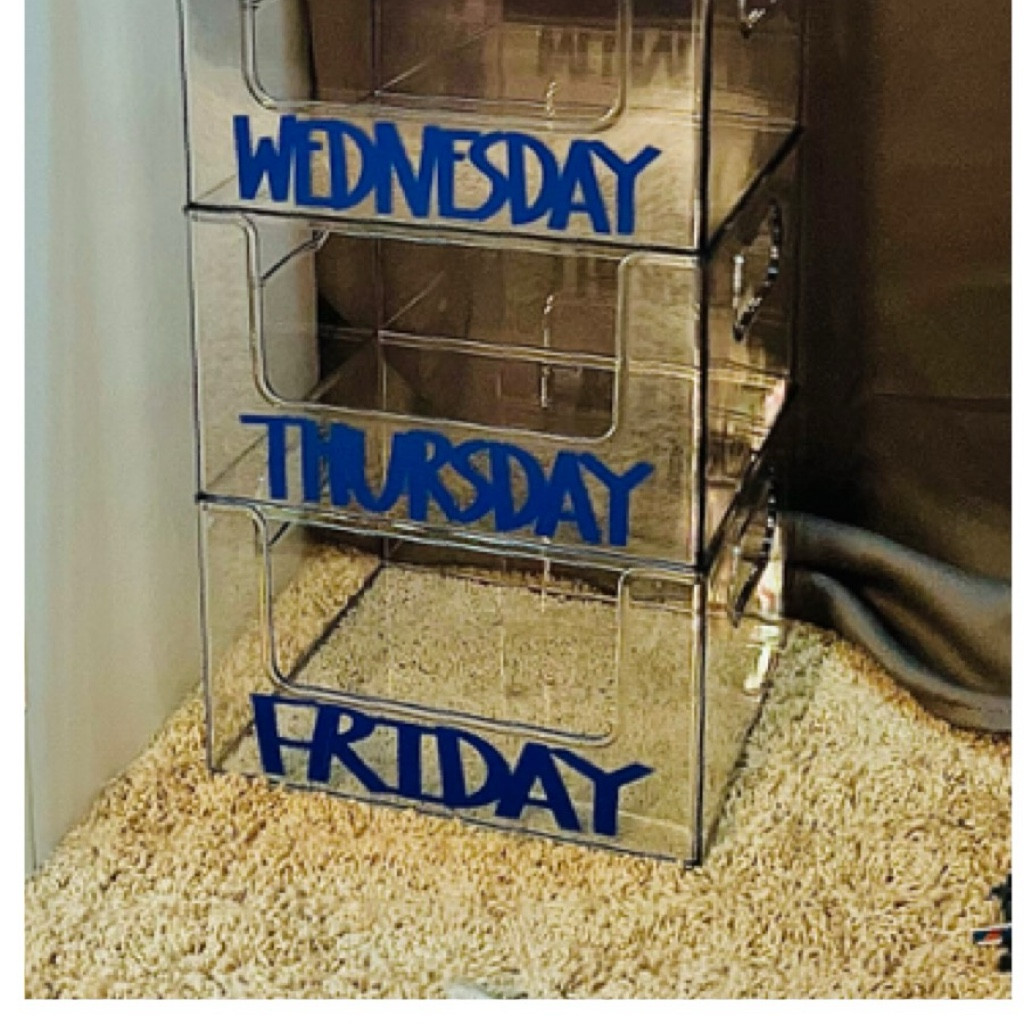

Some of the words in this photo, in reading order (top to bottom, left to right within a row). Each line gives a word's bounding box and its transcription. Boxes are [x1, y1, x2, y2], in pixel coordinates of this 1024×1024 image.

[232, 115, 662, 236] WEDNESDAY
[240, 414, 655, 547] THURSDAY
[252, 694, 655, 837] FRIDAY
